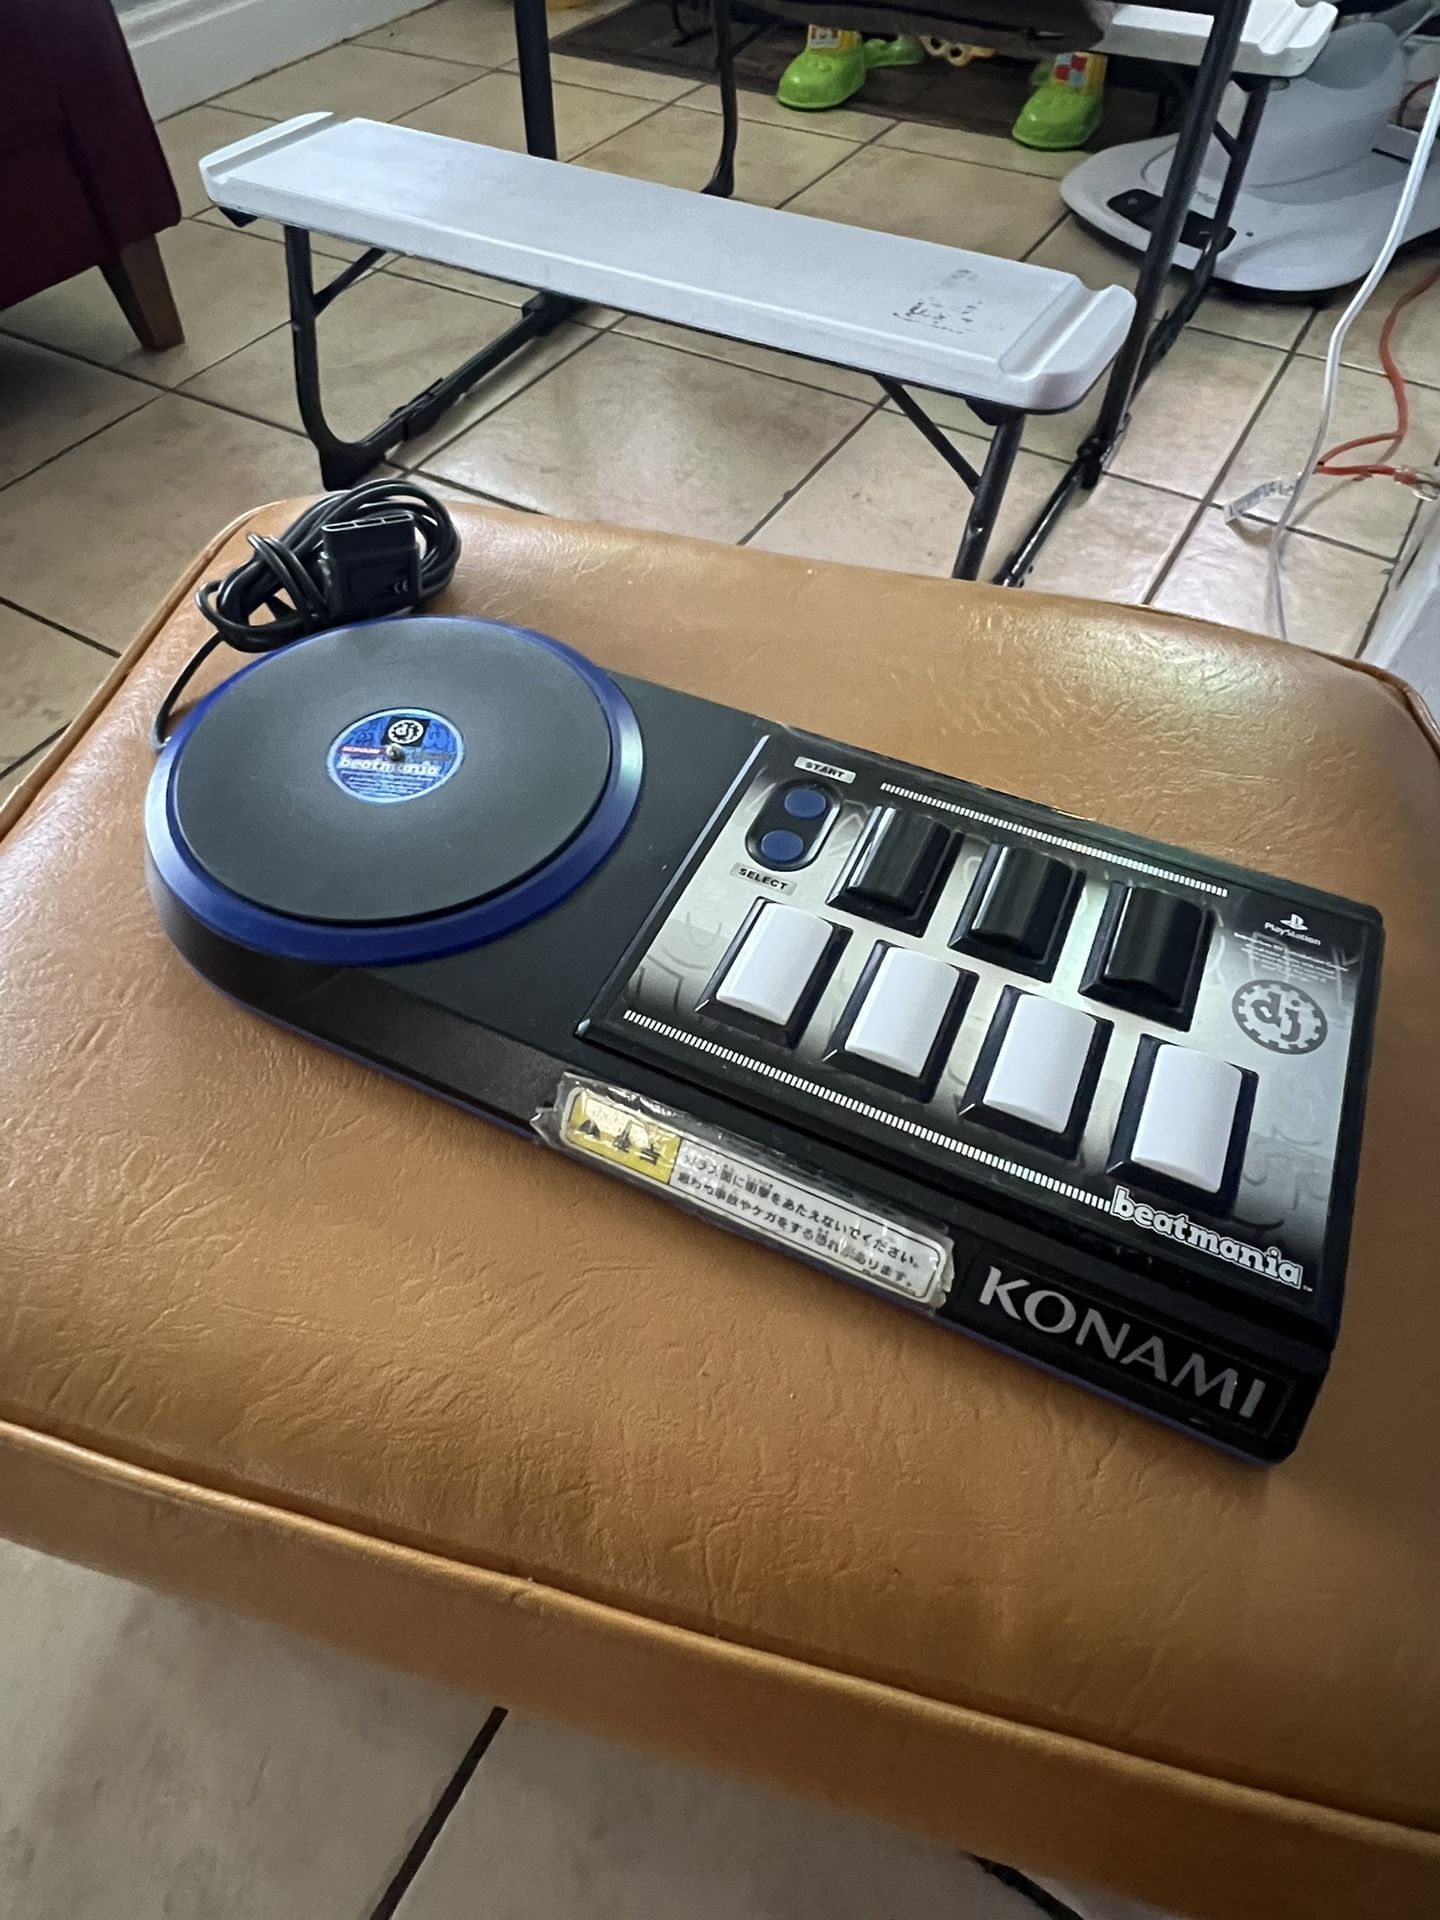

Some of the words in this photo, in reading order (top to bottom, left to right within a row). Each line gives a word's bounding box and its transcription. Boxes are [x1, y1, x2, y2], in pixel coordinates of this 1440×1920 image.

[804, 761, 846, 779] START
[738, 867, 789, 891] SELECT
[1264, 922, 1321, 946] PlayStation
[1110, 1184, 1304, 1290] beatmania
[979, 1266, 1267, 1418] KONAMI
